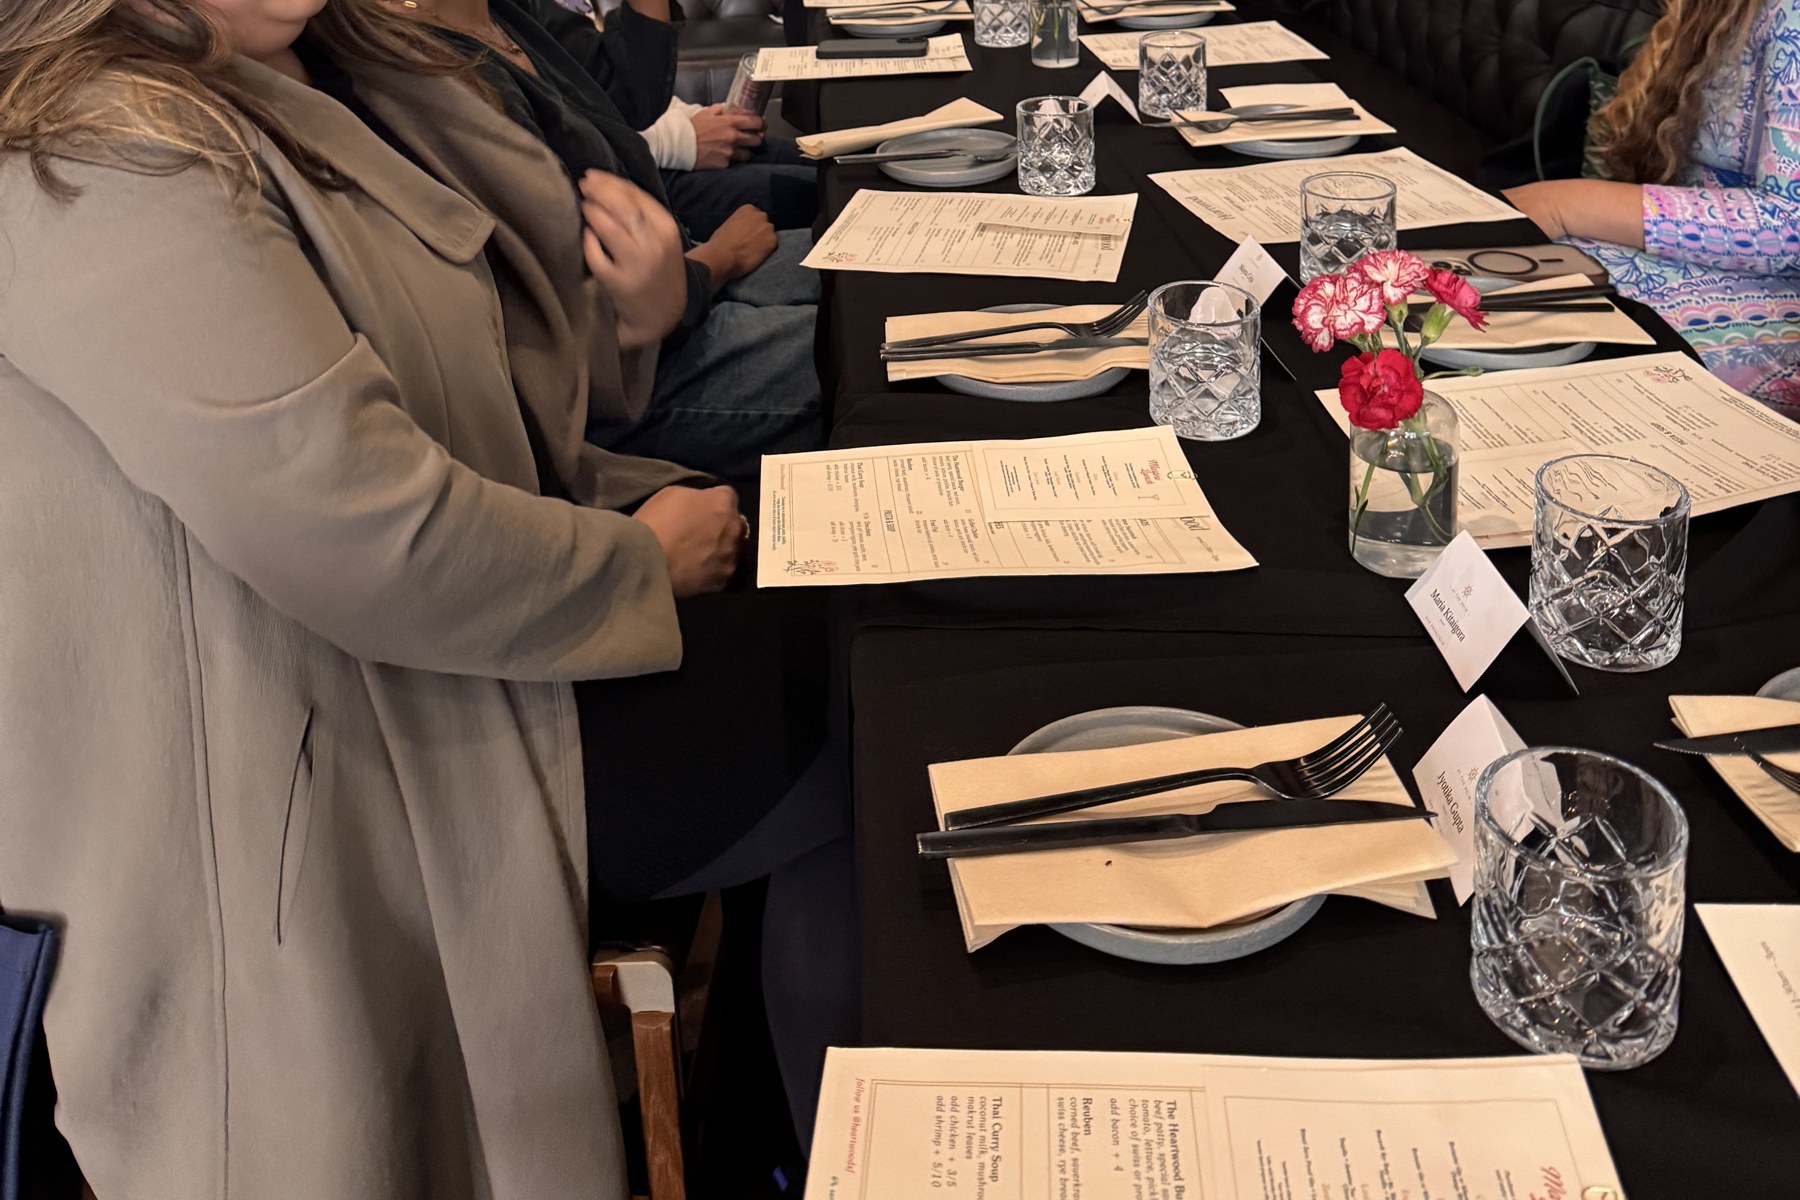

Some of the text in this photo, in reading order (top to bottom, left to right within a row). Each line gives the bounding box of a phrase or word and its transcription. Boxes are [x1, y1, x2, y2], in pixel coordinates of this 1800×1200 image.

[1430, 588, 1448, 613] Maria
[1437, 770, 1465, 835] Jyotika Gupta
[854, 1078, 865, 1103] follow
[935, 1095, 945, 1112] add
[950, 1095, 959, 1112] add
[853, 1104, 861, 1114] us
[978, 1096, 988, 1132] coconut
[1057, 1097, 1067, 1120] swiss
[1069, 1097, 1081, 1129] corned
[1082, 1097, 1093, 1136] Reuben
[1109, 1098, 1121, 1115] add
[1128, 1098, 1140, 1128] choice
[1141, 1099, 1151, 1135] tomato,
[1153, 1100, 1166, 1119] beef
[1166, 1100, 1177, 1120] The
[932, 1115, 944, 1147] shrimp
[948, 1115, 959, 1150] chicken
[965, 1096, 975, 1160] makrut leaves
[989, 1096, 1003, 1183] Thai Curry Soup
[1057, 1122, 1068, 1156] cheese,
[1110, 1118, 1122, 1146] bacon
[1129, 1130, 1140, 1142] of
[1153, 1122, 1165, 1150] patty,
[977, 1135, 989, 1159] milk,
[1070, 1131, 1082, 1154] beef,
[1168, 1123, 1184, 1181] Heartwood
[1131, 1144, 1141, 1168] swiss
[1156, 1152, 1171, 1186] special
[931, 1162, 943, 1188] 5/10
[946, 1169, 957, 1188] 3/5
[1133, 1170, 1143, 1182] or
